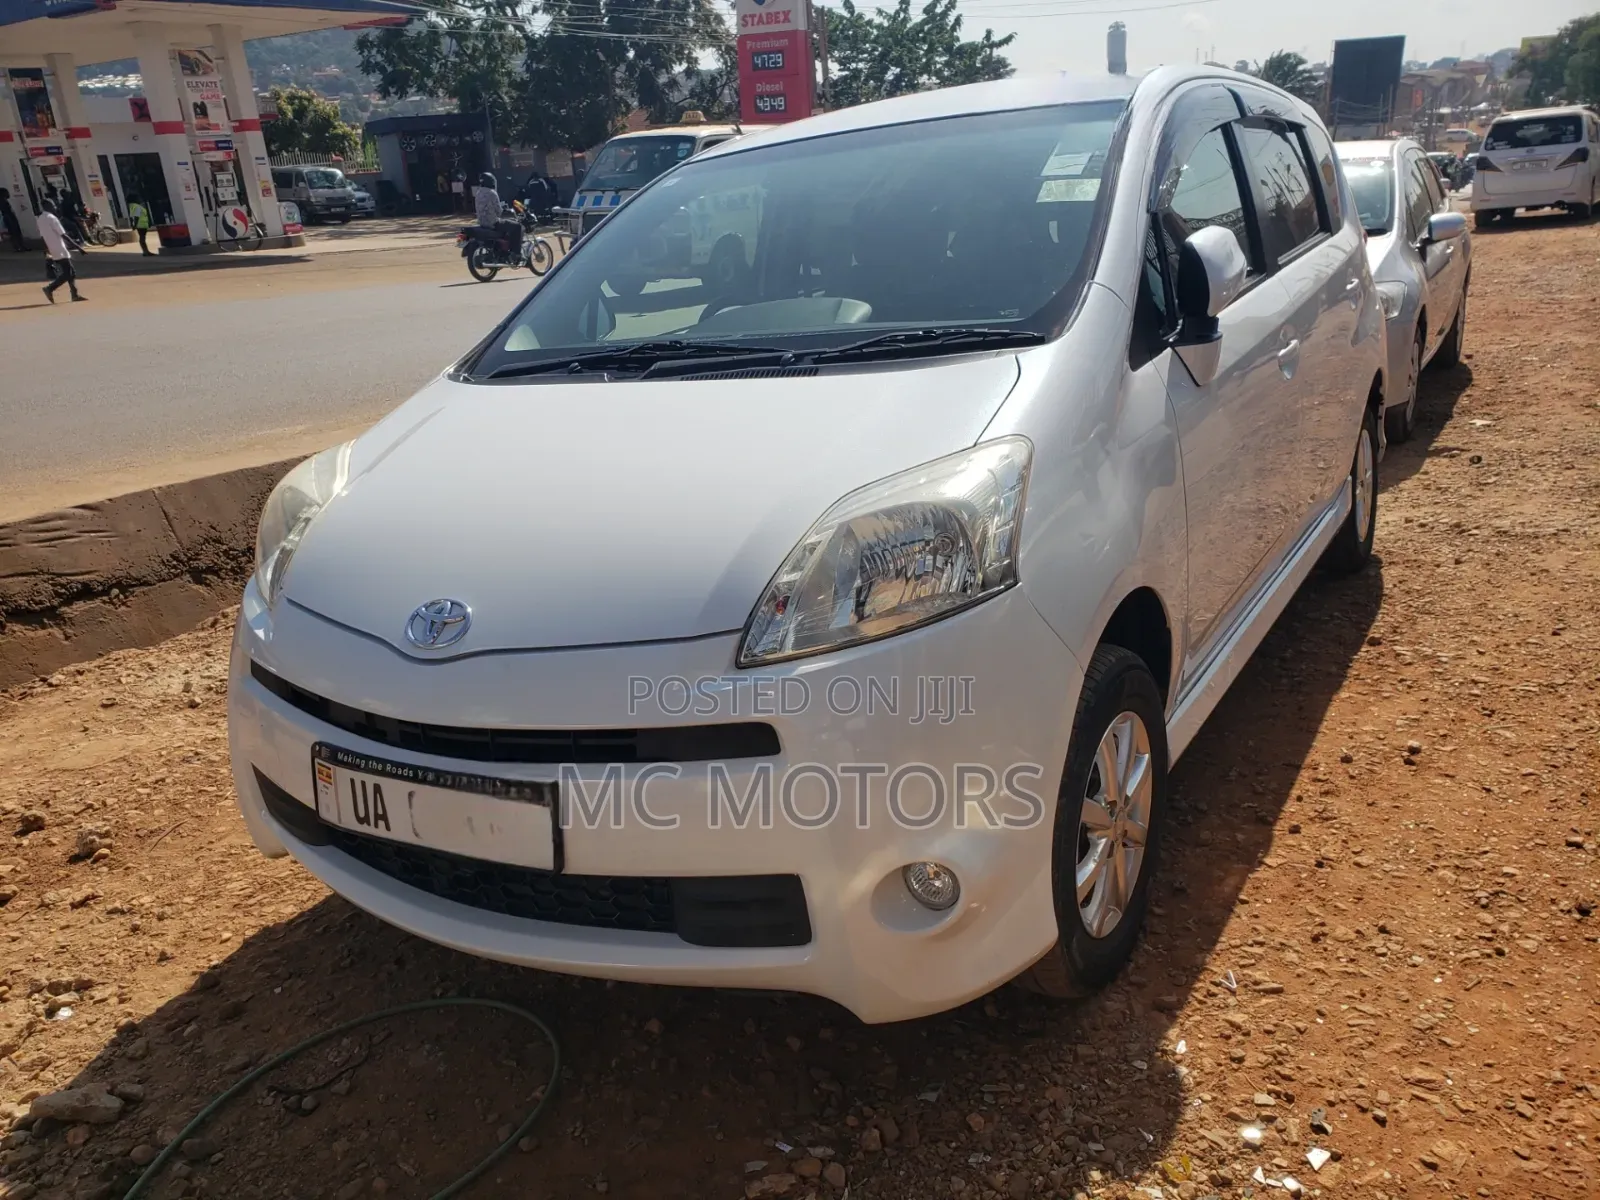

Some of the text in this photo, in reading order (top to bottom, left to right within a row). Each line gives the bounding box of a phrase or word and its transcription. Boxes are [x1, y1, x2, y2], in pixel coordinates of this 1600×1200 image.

[741, 10, 791, 27] STABEX
[746, 38, 789, 50] Premium
[753, 53, 783, 68] 4729
[186, 81, 218, 89] ELEVATE
[756, 81, 784, 92] Diesel
[756, 97, 786, 111] 4349
[337, 751, 365, 769] Making
[368, 760, 382, 771] the
[385, 763, 414, 778] Roads
[350, 777, 392, 832] UA
